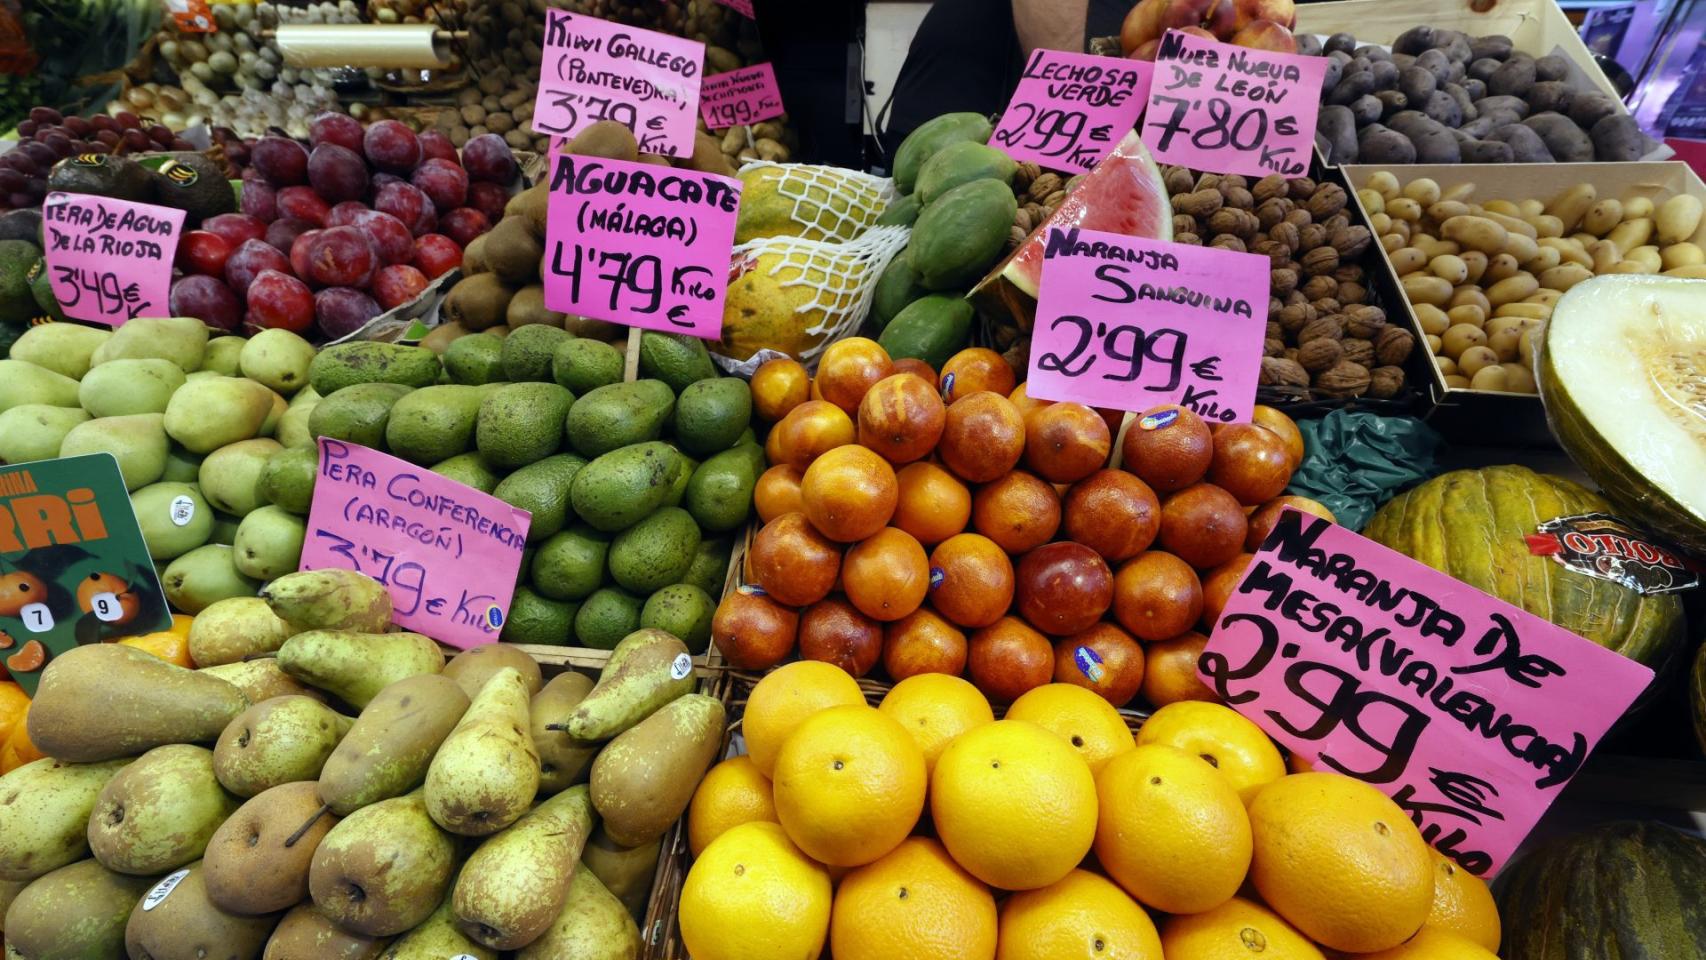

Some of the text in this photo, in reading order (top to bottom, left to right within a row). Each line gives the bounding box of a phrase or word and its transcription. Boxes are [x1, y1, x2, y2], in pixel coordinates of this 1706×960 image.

[547, 11, 697, 78] KIWI GALLEGO
[1157, 33, 1219, 68] NUEZ
[1022, 51, 1138, 89] LECHOSA
[1165, 65, 1203, 90] DE
[1048, 84, 1133, 107] VERDE
[646, 116, 668, 130] €
[996, 103, 1113, 157] 2'99 €
[1148, 94, 1299, 152] 7'80 €
[638, 133, 678, 156] KILO
[1066, 144, 1102, 170] KIL
[1258, 145, 1305, 175] KILO
[550, 156, 737, 213] AGUACATE
[88, 203, 117, 233] DE
[117, 208, 172, 236] AGUA
[577, 201, 698, 247] (MÁLAGA)
[50, 227, 162, 261] DE LA RIOJA
[1044, 227, 1179, 272] NARANJA
[551, 241, 716, 314] 4'79 KILO
[1091, 264, 1252, 319] SANGUINA
[666, 305, 696, 327] €
[1037, 315, 1223, 392] 2'99 €
[1180, 384, 1237, 421] KILO
[322, 439, 526, 550] PERA CONFERENCIA
[98, 600, 109, 614] 9
[426, 598, 447, 615] €
[1260, 509, 1567, 688] NARANJA DE
[32, 610, 44, 625] 7
[1198, 614, 1504, 821] 2'99 €
